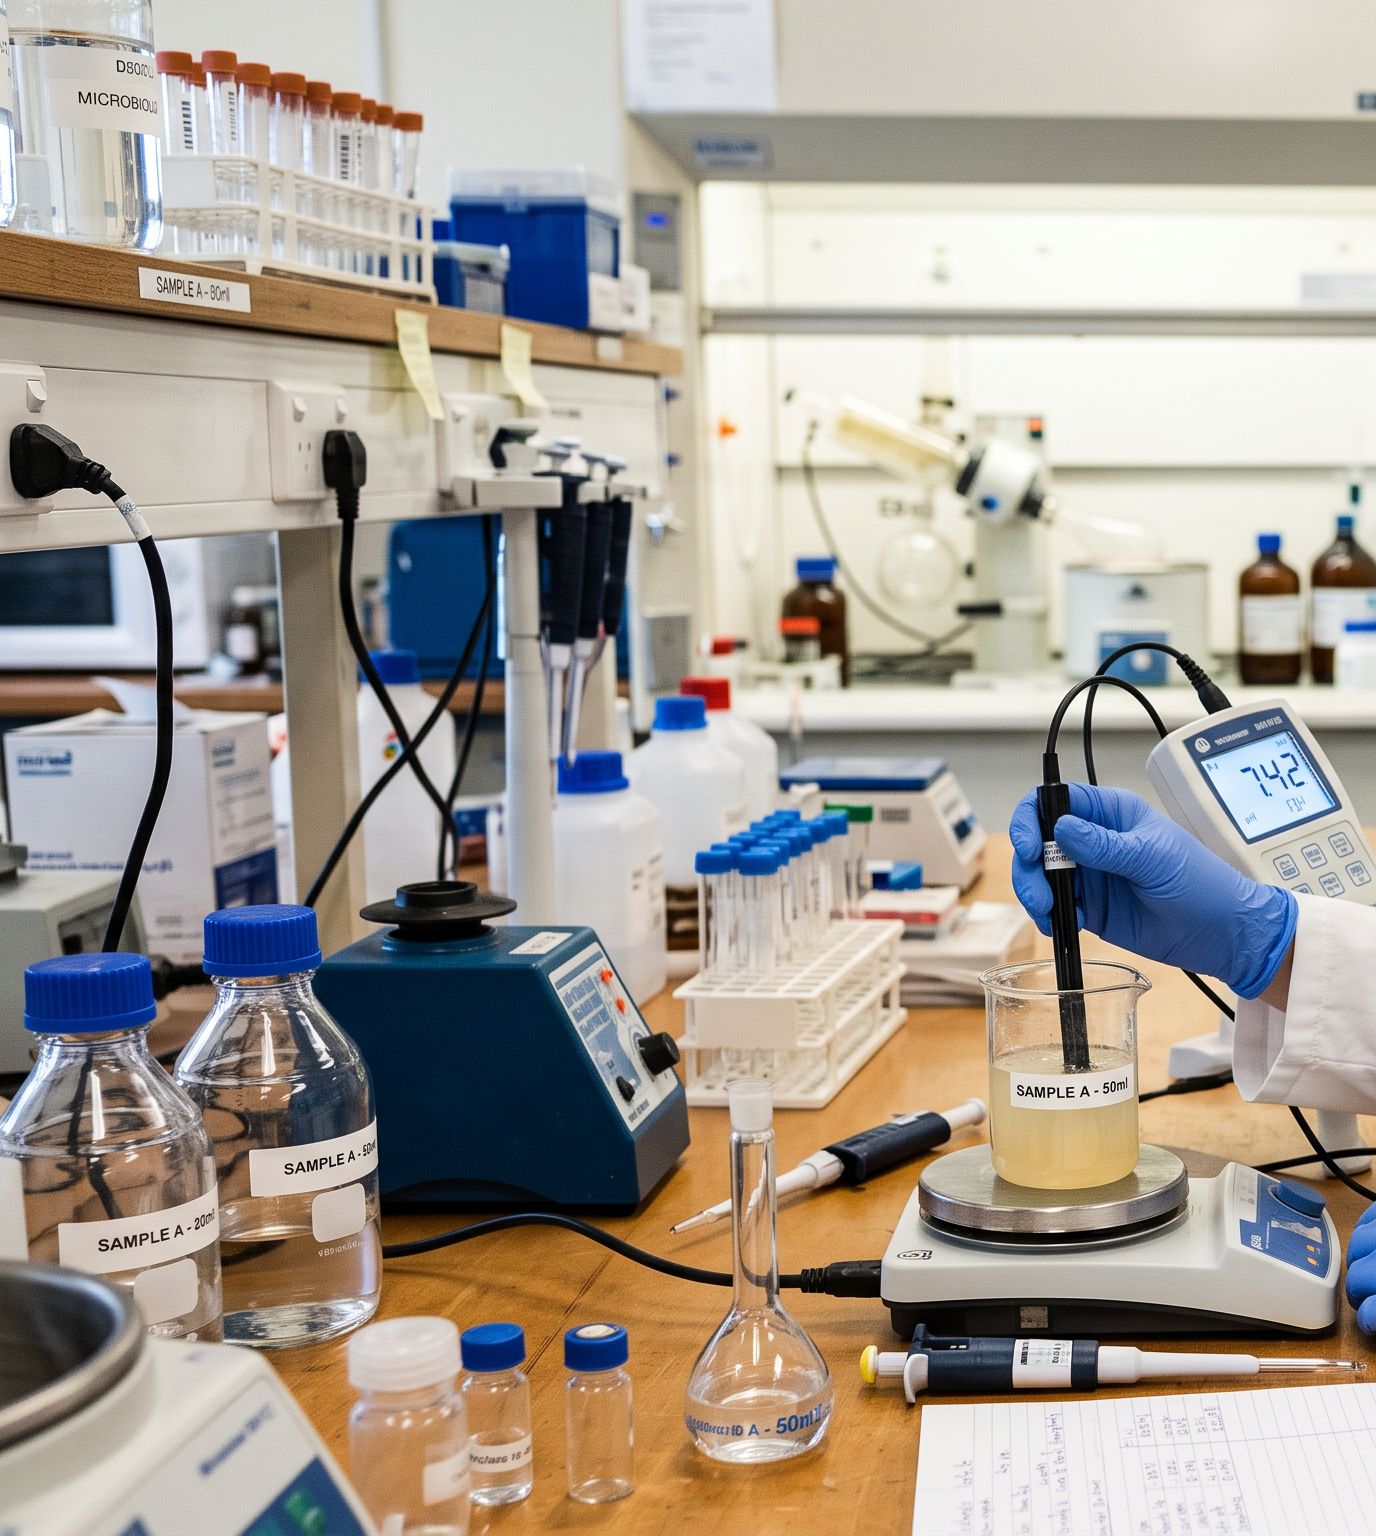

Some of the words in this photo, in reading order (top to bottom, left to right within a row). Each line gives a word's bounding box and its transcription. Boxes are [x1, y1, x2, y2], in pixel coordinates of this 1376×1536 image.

[156, 276, 194, 298] SAMPLE
[196, 282, 203, 299] A
[1240, 752, 1305, 798] 7.42
[1016, 1085, 1076, 1099] SAMPLE
[1079, 1086, 1091, 1098] A
[1102, 1076, 1129, 1095] 50ml
[284, 1153, 345, 1175] SAMPLE
[347, 1150, 356, 1163] A
[98, 1227, 171, 1252] SAMPLE
[174, 1224, 184, 1238] A
